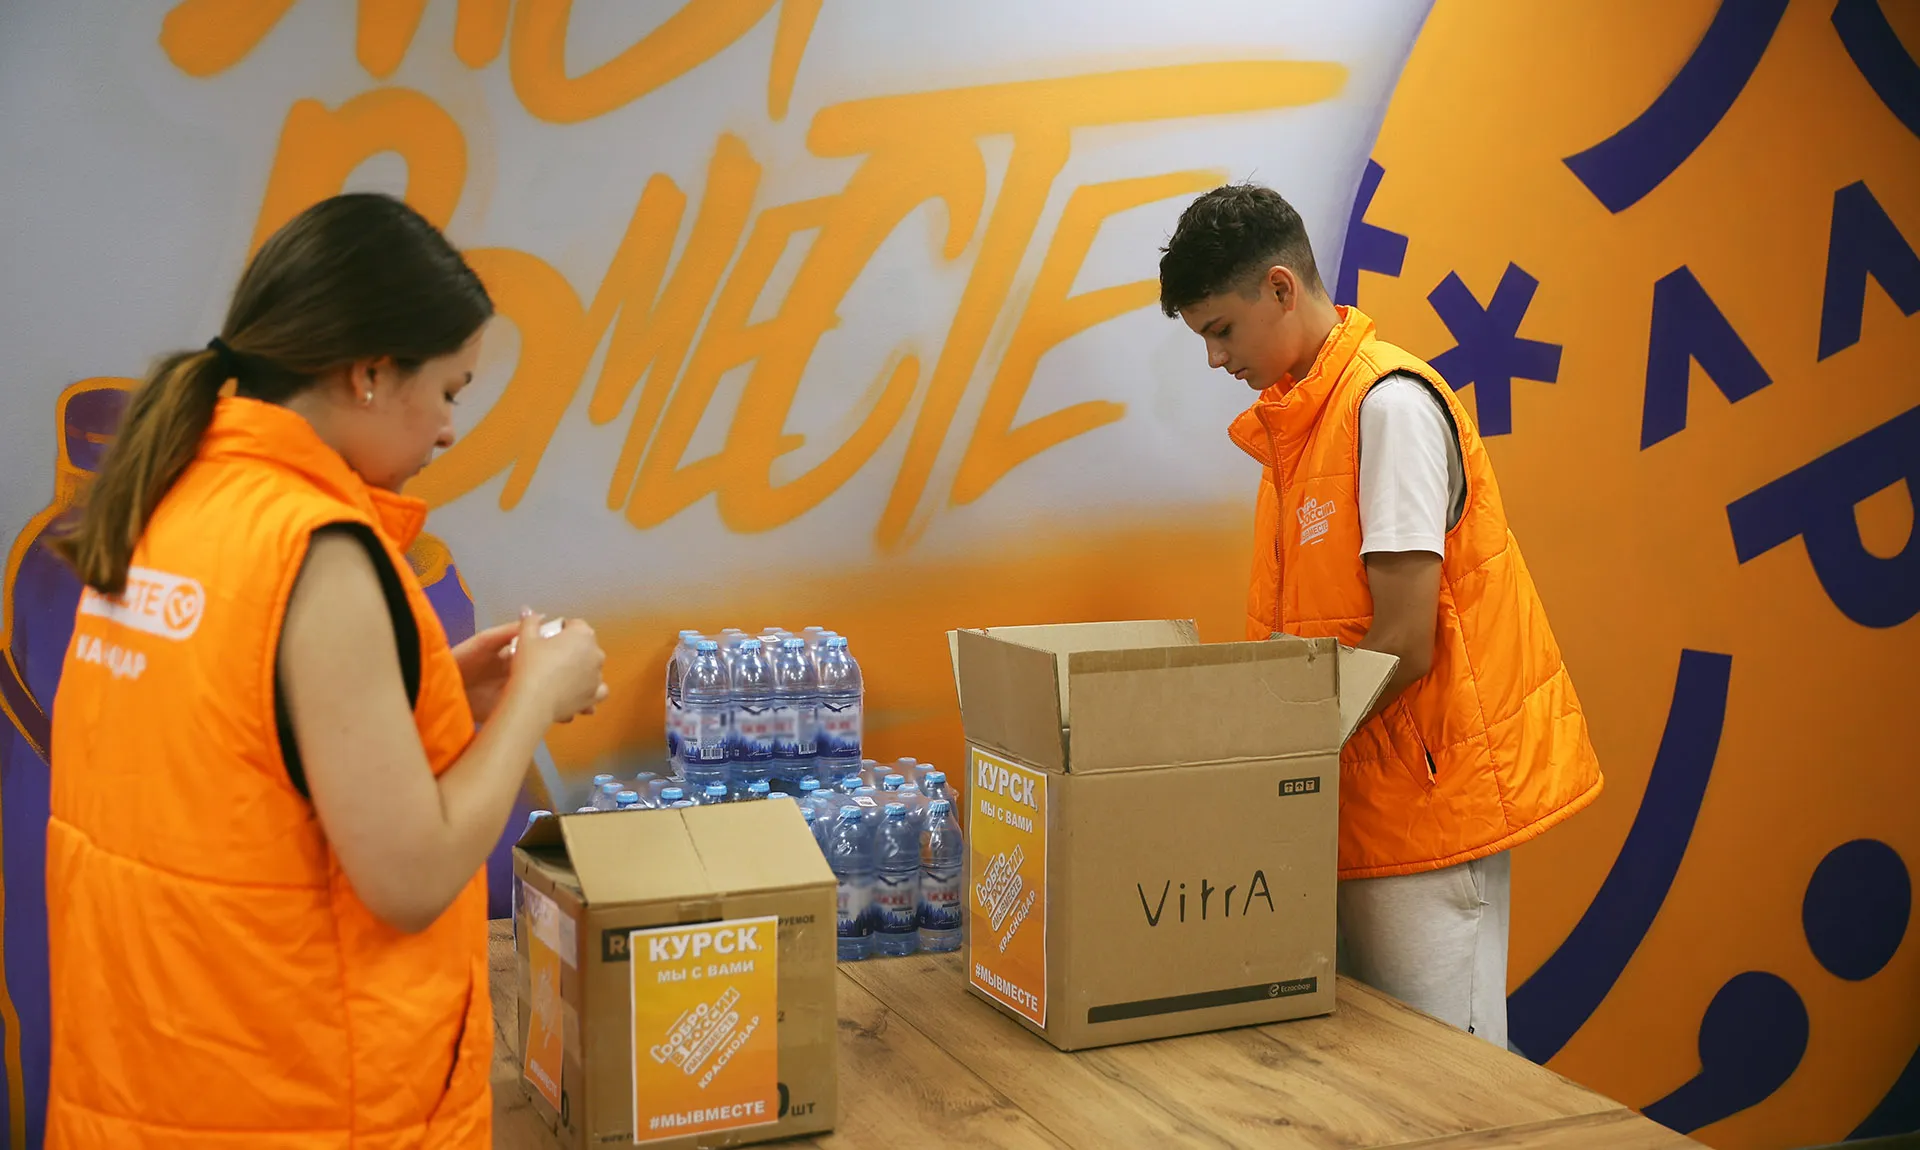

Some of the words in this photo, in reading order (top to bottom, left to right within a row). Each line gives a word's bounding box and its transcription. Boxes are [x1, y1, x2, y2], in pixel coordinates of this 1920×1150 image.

[978, 759, 1038, 811] КУРСК,
[981, 799, 995, 818] МЫ
[997, 807, 1004, 821] С
[1005, 810, 1033, 833] ВАМИ
[998, 890, 1036, 953] КРАСНОДАР
[649, 926, 763, 962] КУРСК,
[657, 968, 687, 983] МЫ
[691, 965, 702, 979] С
[707, 960, 754, 978] ВАМИ
[975, 962, 1038, 1013] #МЫВМЕСТЕ
[698, 1015, 760, 1090] КРАСНОДАР
[649, 1100, 766, 1131] #МЫВМЕСТЕ
